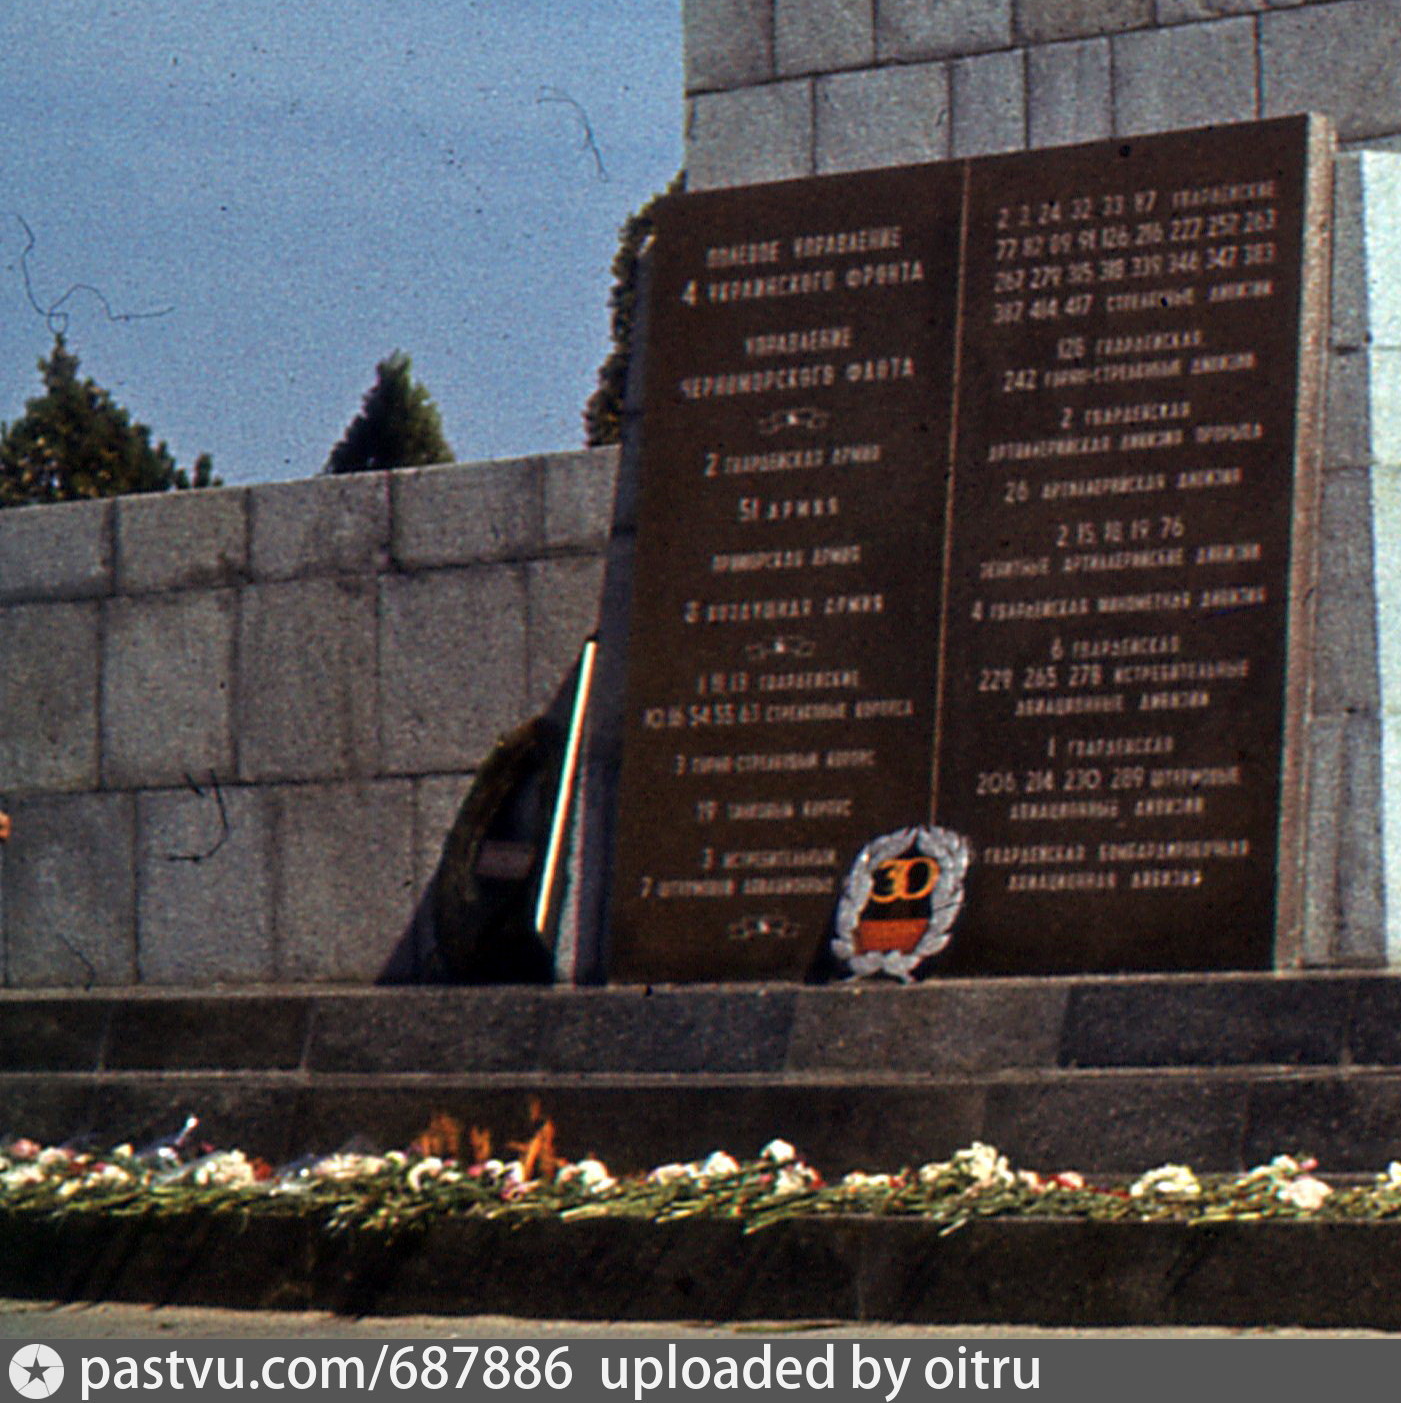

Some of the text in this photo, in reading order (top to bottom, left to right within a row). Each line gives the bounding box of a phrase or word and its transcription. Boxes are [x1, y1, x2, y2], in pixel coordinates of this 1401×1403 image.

[794, 226, 902, 258] УПРАВЛЕНИЕ
[682, 279, 697, 305] 4
[845, 261, 924, 288] ФРОНТА
[746, 327, 852, 355] УПРАВЛЕНИЕ
[681, 357, 915, 398] ЧЕРНОМОРСКОГО ФЛОТА
[705, 452, 719, 478] 2
[739, 497, 761, 522] 51
[872, 856, 941, 903] 30
